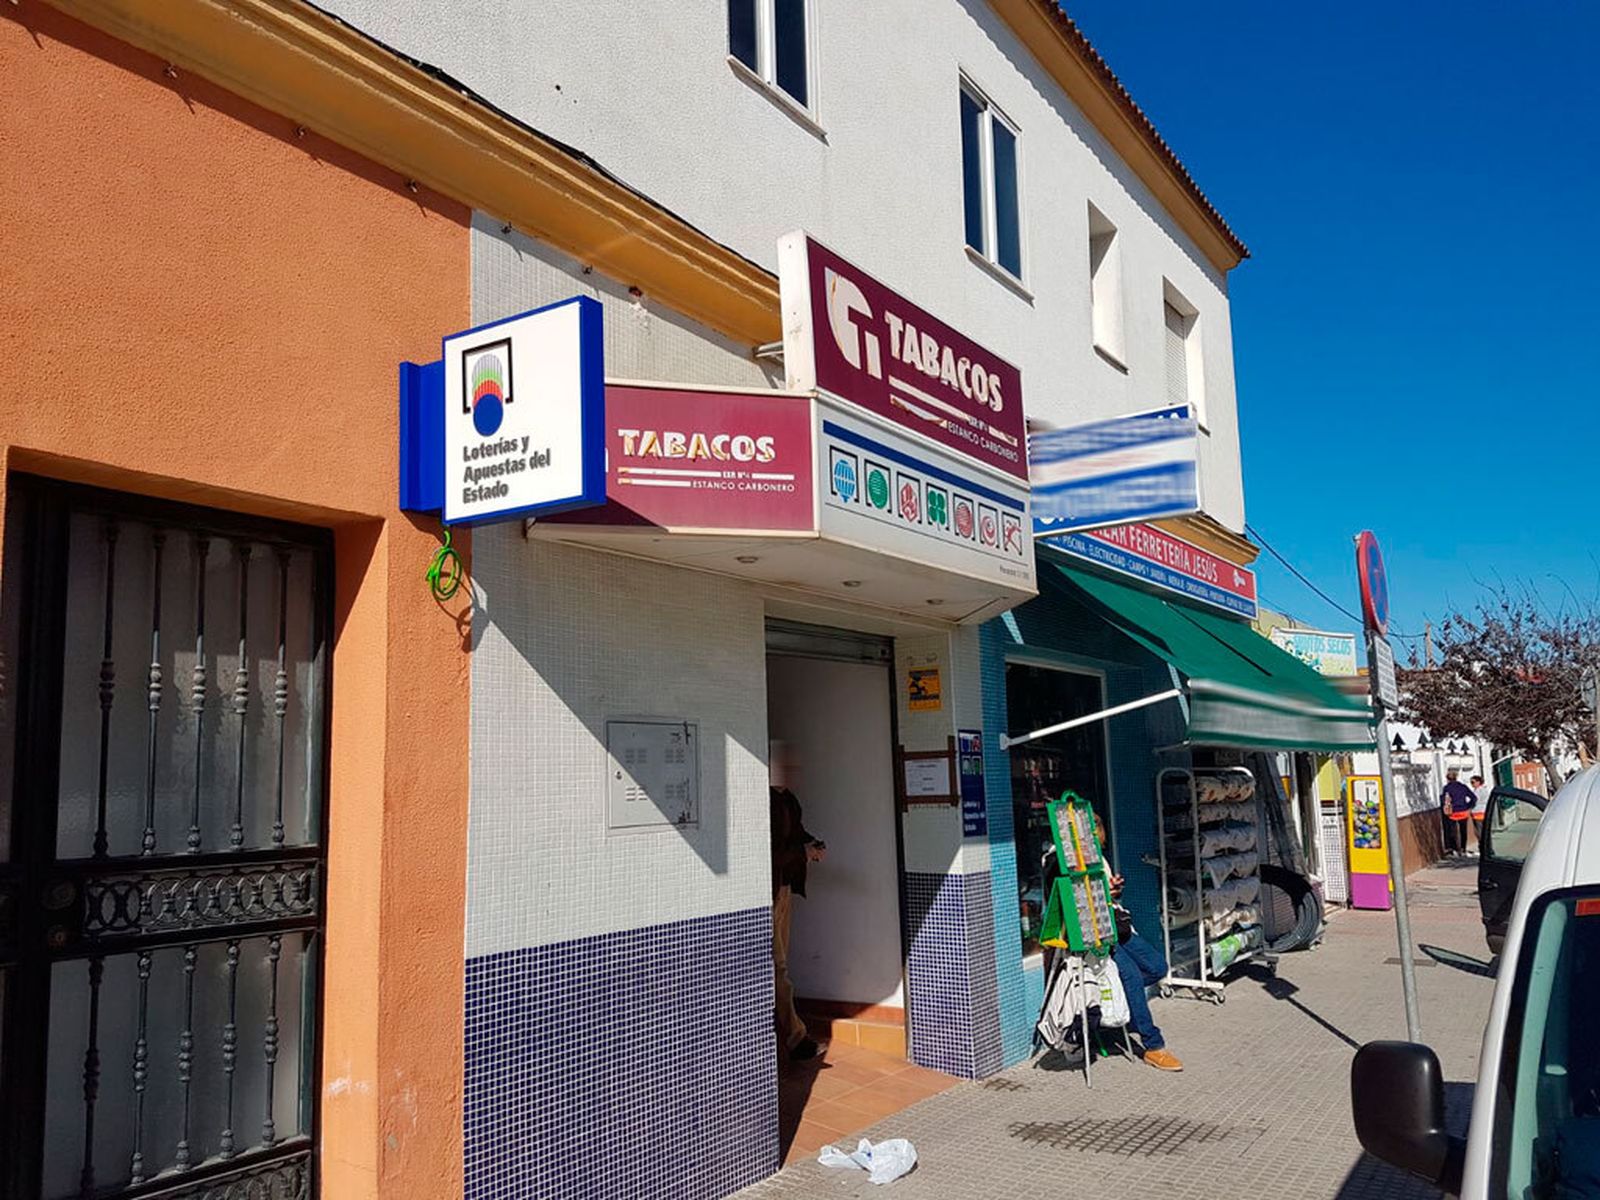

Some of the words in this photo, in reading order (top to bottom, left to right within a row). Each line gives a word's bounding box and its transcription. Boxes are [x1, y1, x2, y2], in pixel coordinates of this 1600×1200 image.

[884, 310, 1003, 412] TABACOS
[463, 437, 518, 462] Loterías
[521, 435, 530, 454] y
[618, 429, 776, 463] TABACOS
[463, 458, 526, 485] Apuestas
[529, 448, 551, 470] del
[463, 480, 509, 504] Estado
[692, 480, 735, 490] ESTANCO
[738, 482, 795, 492] CARBONERO
[1129, 525, 1191, 572] FERRETERÍA
[1192, 554, 1219, 582] JESÚS
